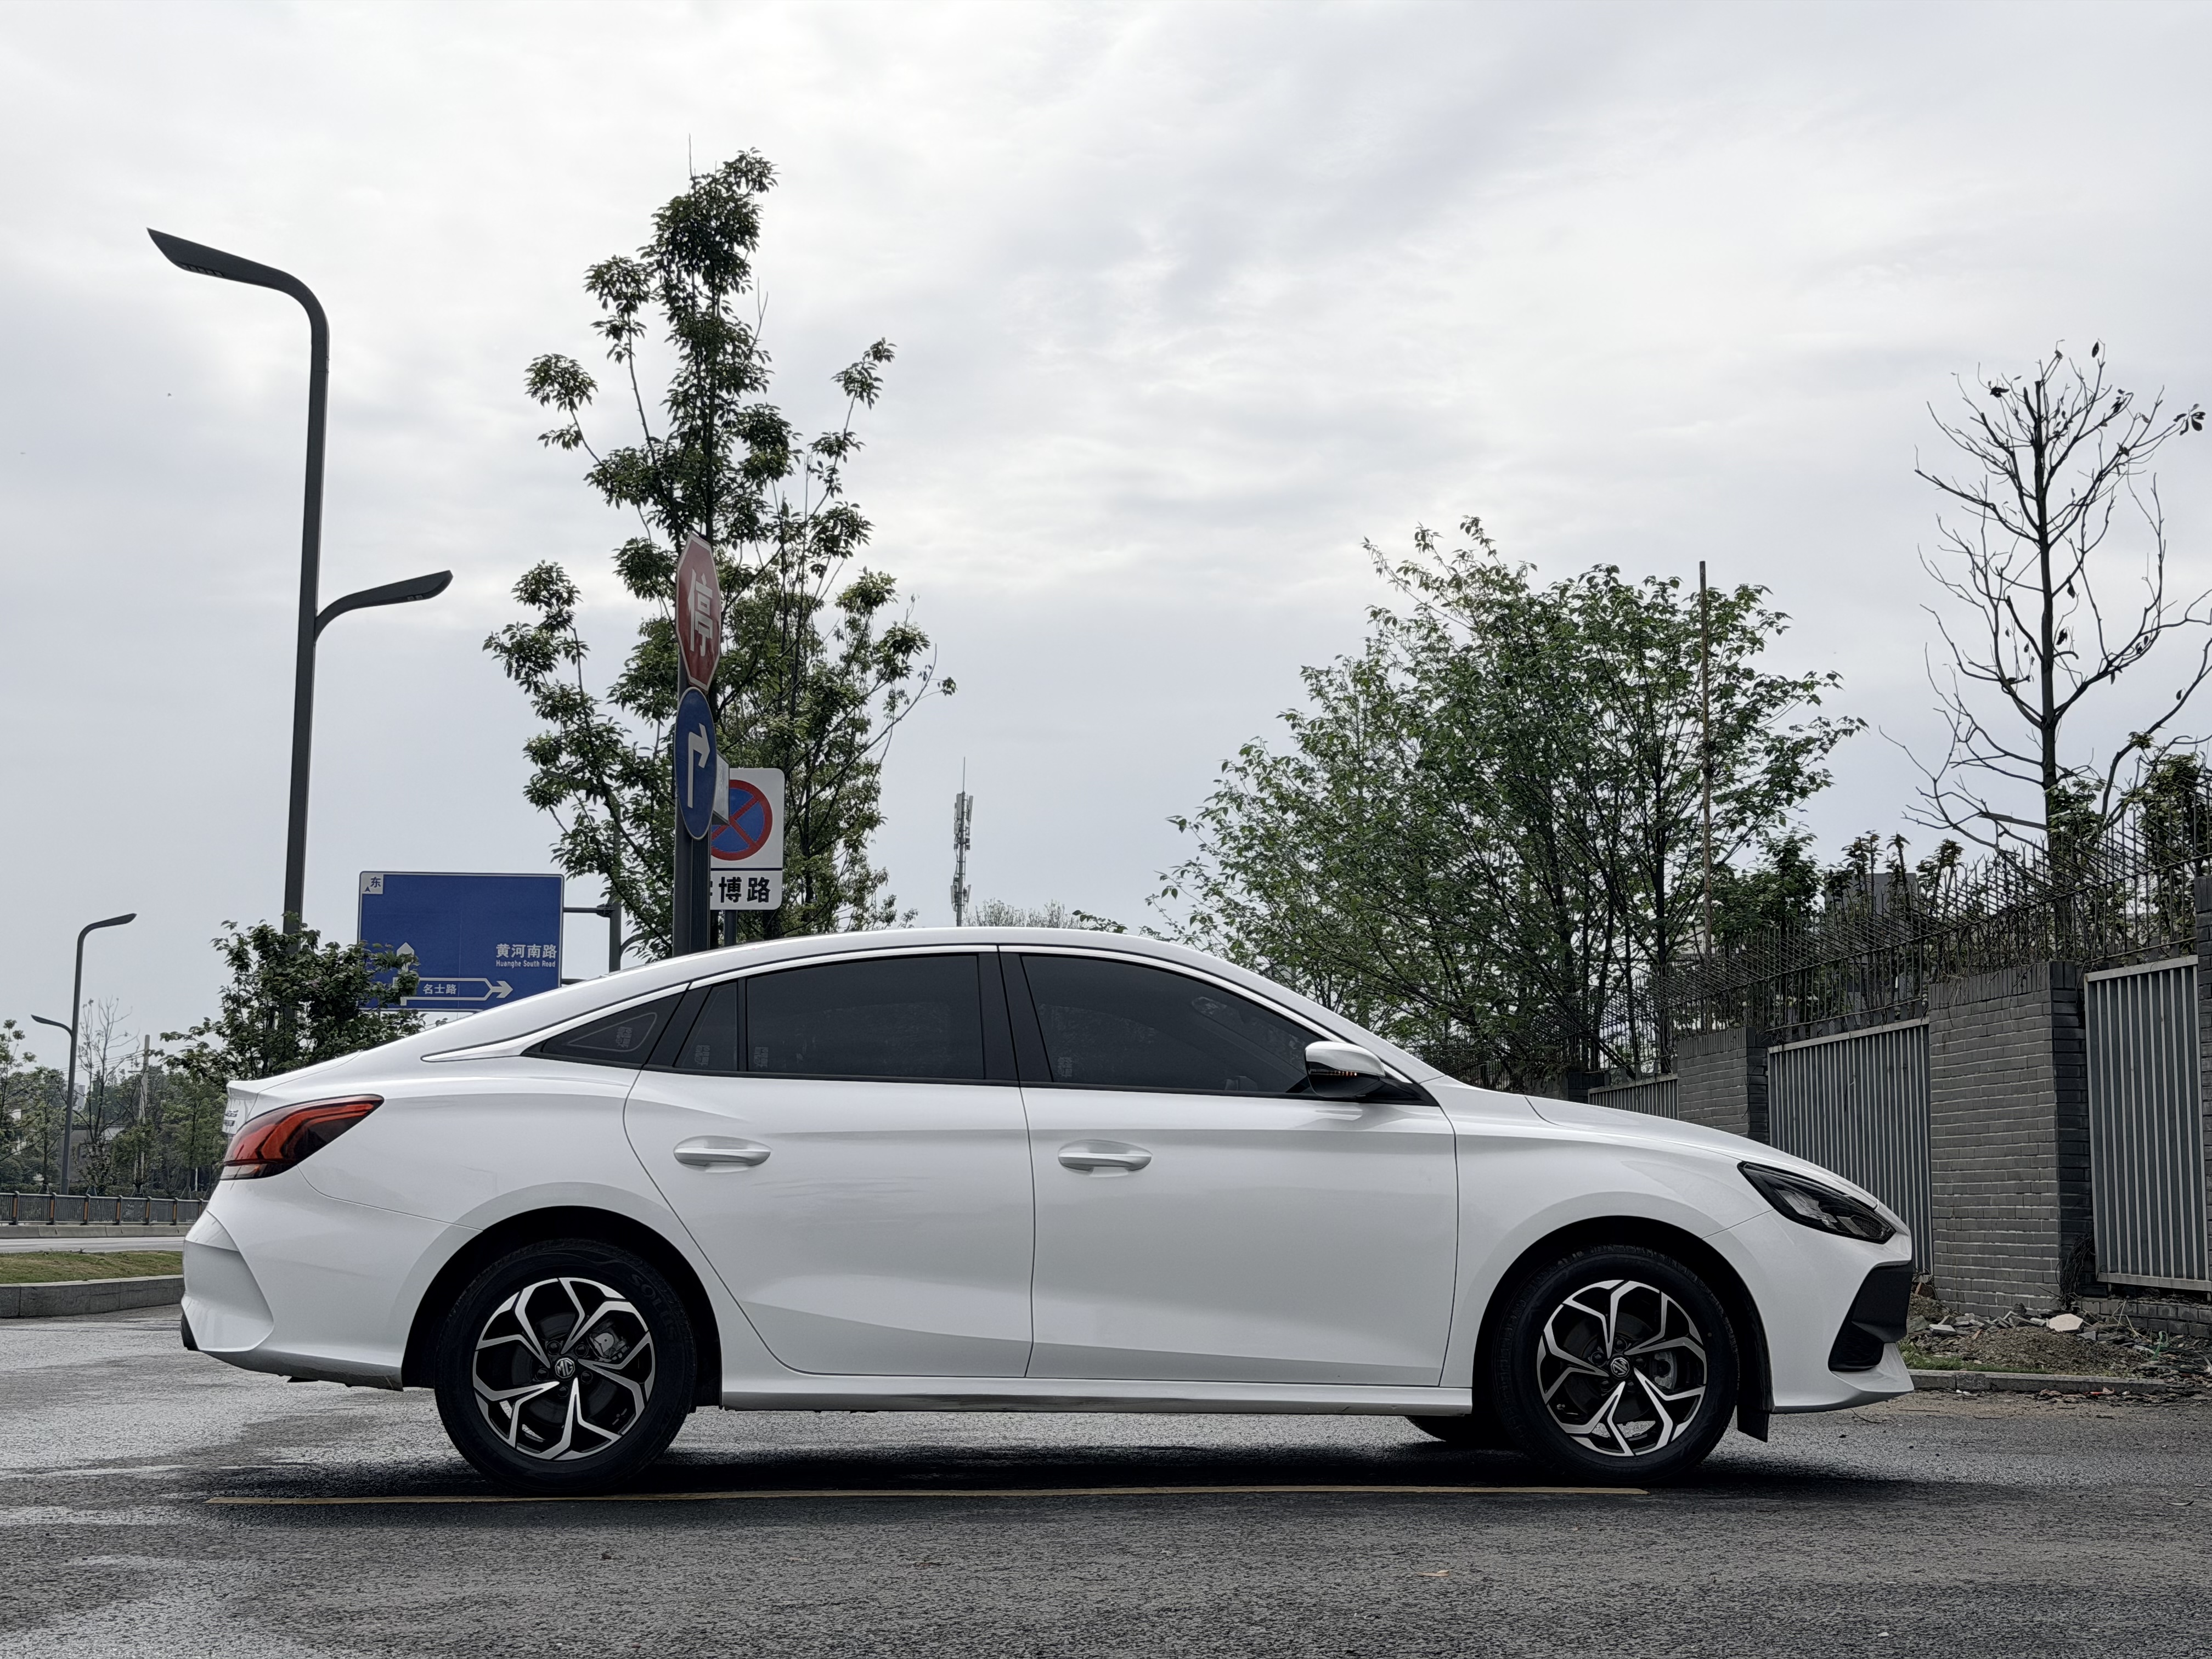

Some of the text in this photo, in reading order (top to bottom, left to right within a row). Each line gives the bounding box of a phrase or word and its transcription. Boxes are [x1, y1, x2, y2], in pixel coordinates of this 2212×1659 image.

[687, 568, 713, 657] 停
[370, 877, 381, 888] 东
[710, 877, 771, 902] 博路
[496, 944, 557, 958] 黄河南路
[496, 960, 522, 968] Huanghe
[422, 984, 457, 994] 名士路
[557, 1360, 573, 1376] MG
